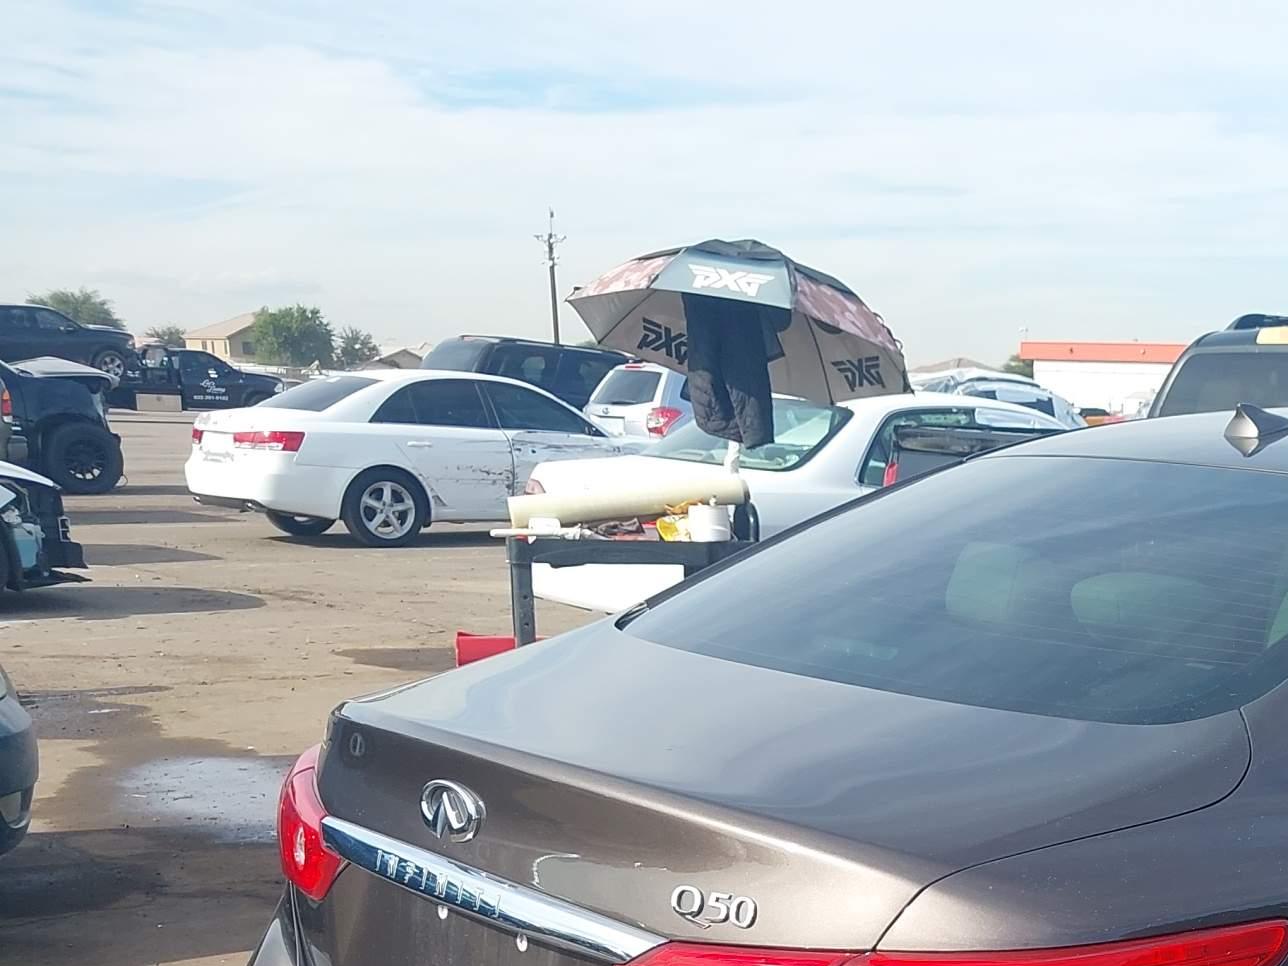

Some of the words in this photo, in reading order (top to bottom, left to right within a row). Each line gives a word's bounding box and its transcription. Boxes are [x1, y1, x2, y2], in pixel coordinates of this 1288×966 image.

[688, 264, 775, 297] PXG
[831, 355, 887, 393] PXG
[375, 849, 502, 919] INFINITI
[671, 885, 758, 930] Q50
